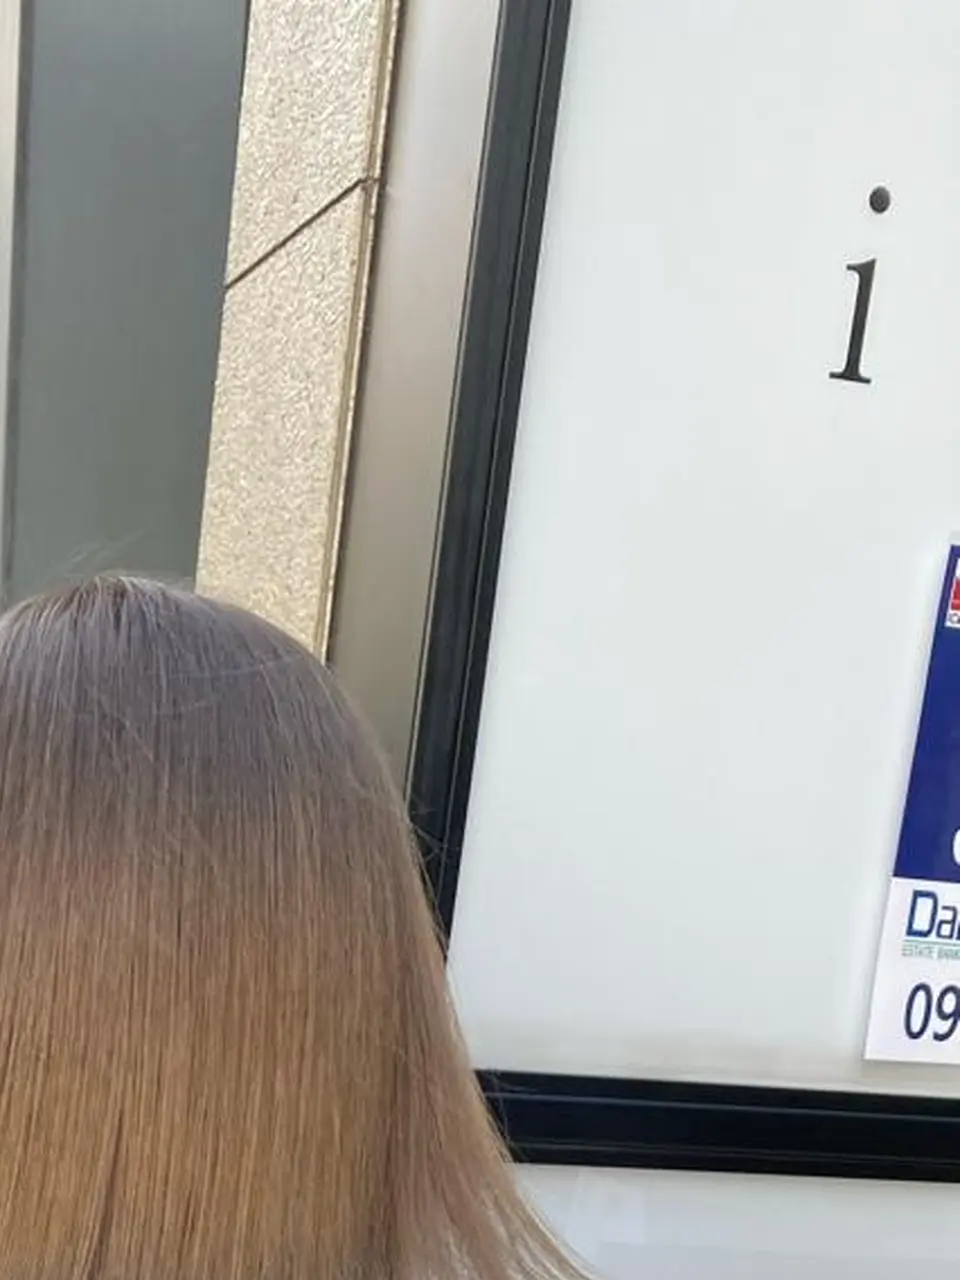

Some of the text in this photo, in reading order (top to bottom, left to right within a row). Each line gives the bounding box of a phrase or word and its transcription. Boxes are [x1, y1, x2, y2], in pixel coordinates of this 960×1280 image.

[829, 186, 891, 384] i
[906, 889, 960, 942] Da
[904, 982, 960, 1042] 09
